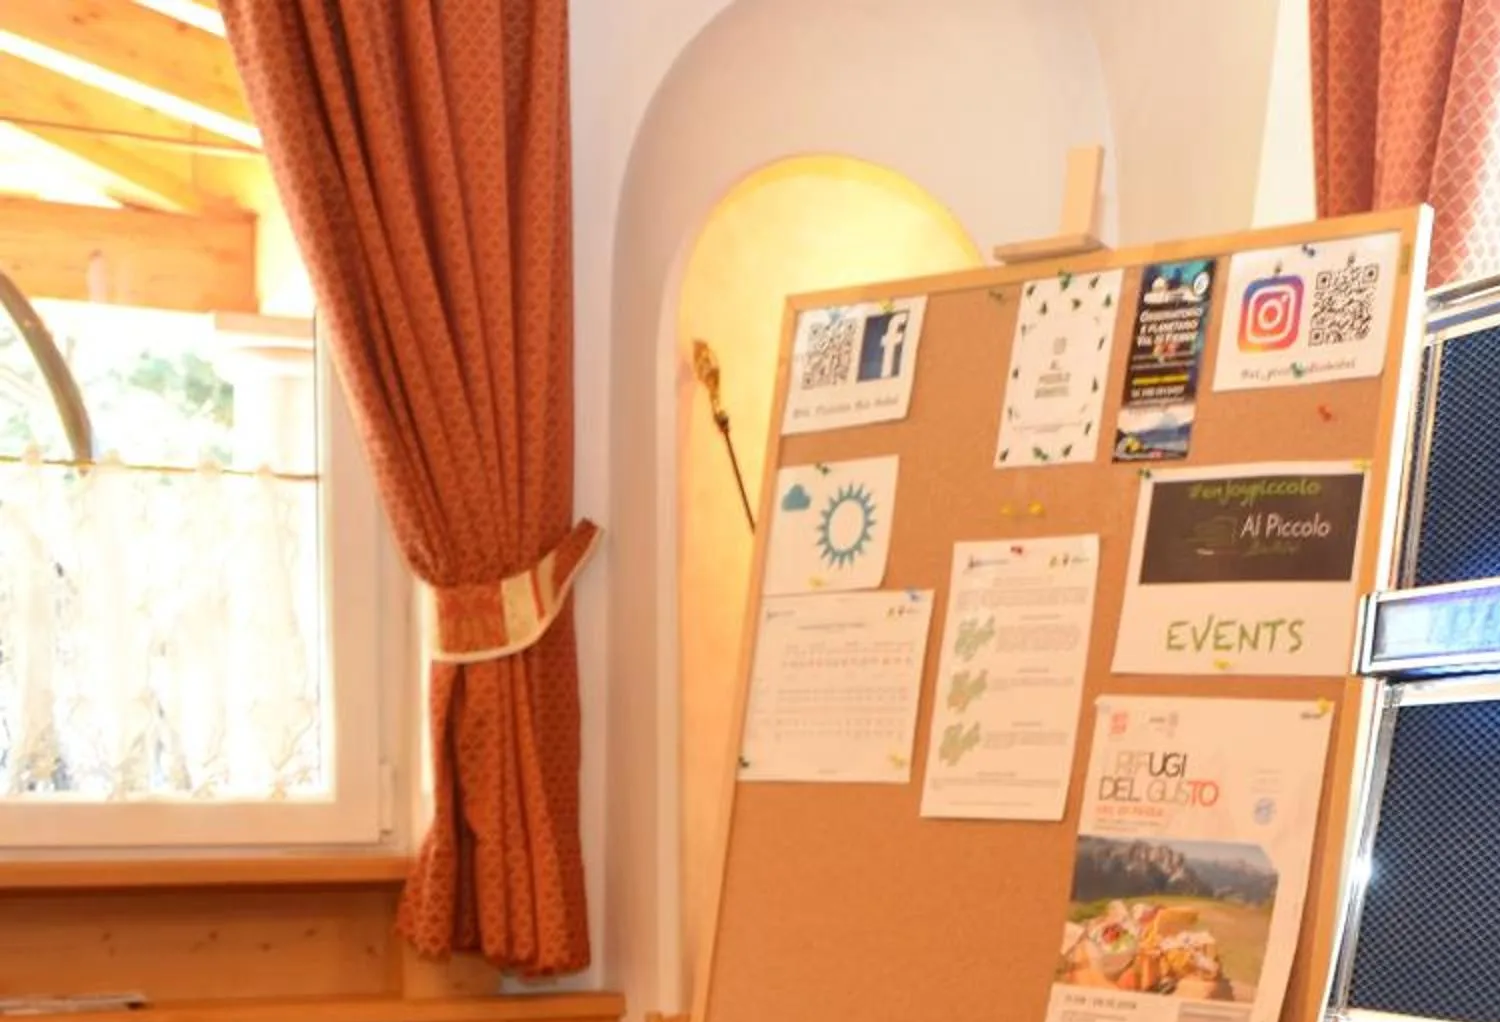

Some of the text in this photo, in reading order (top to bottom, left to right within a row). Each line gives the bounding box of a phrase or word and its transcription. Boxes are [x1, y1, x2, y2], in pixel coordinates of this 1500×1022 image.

[1240, 512, 1331, 538] Al Piccolo
[1166, 614, 1305, 654] EVENTS
[1098, 776, 1141, 802] DEL
[1146, 778, 1220, 807] GUSTO
